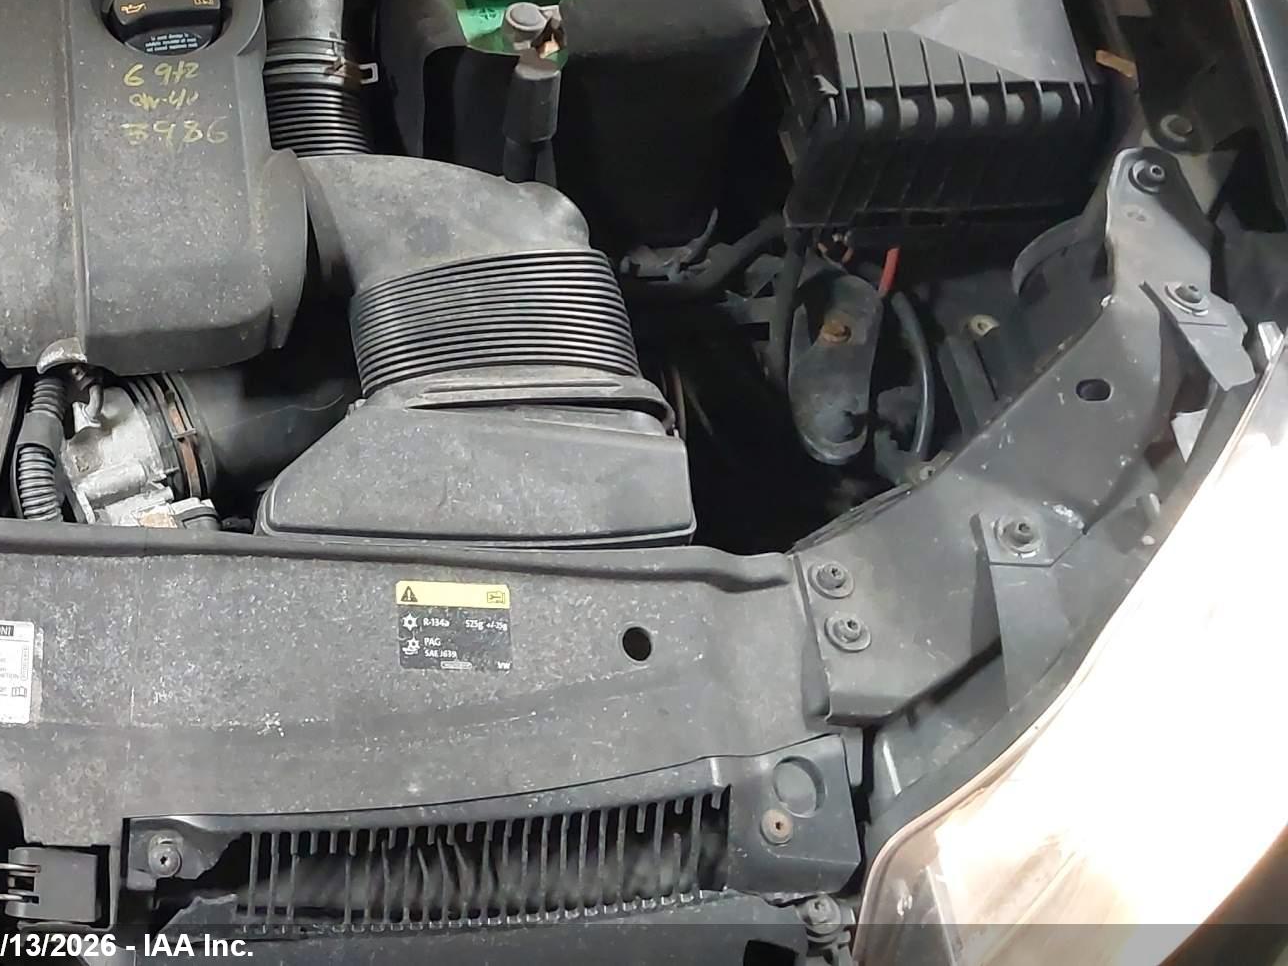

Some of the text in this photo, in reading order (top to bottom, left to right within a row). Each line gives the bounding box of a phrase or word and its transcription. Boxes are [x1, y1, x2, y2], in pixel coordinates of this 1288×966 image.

[124, 64, 145, 86] 6
[423, 618, 450, 627] R-134a
[424, 637, 441, 646] PAG
[425, 650, 438, 658] SAE
